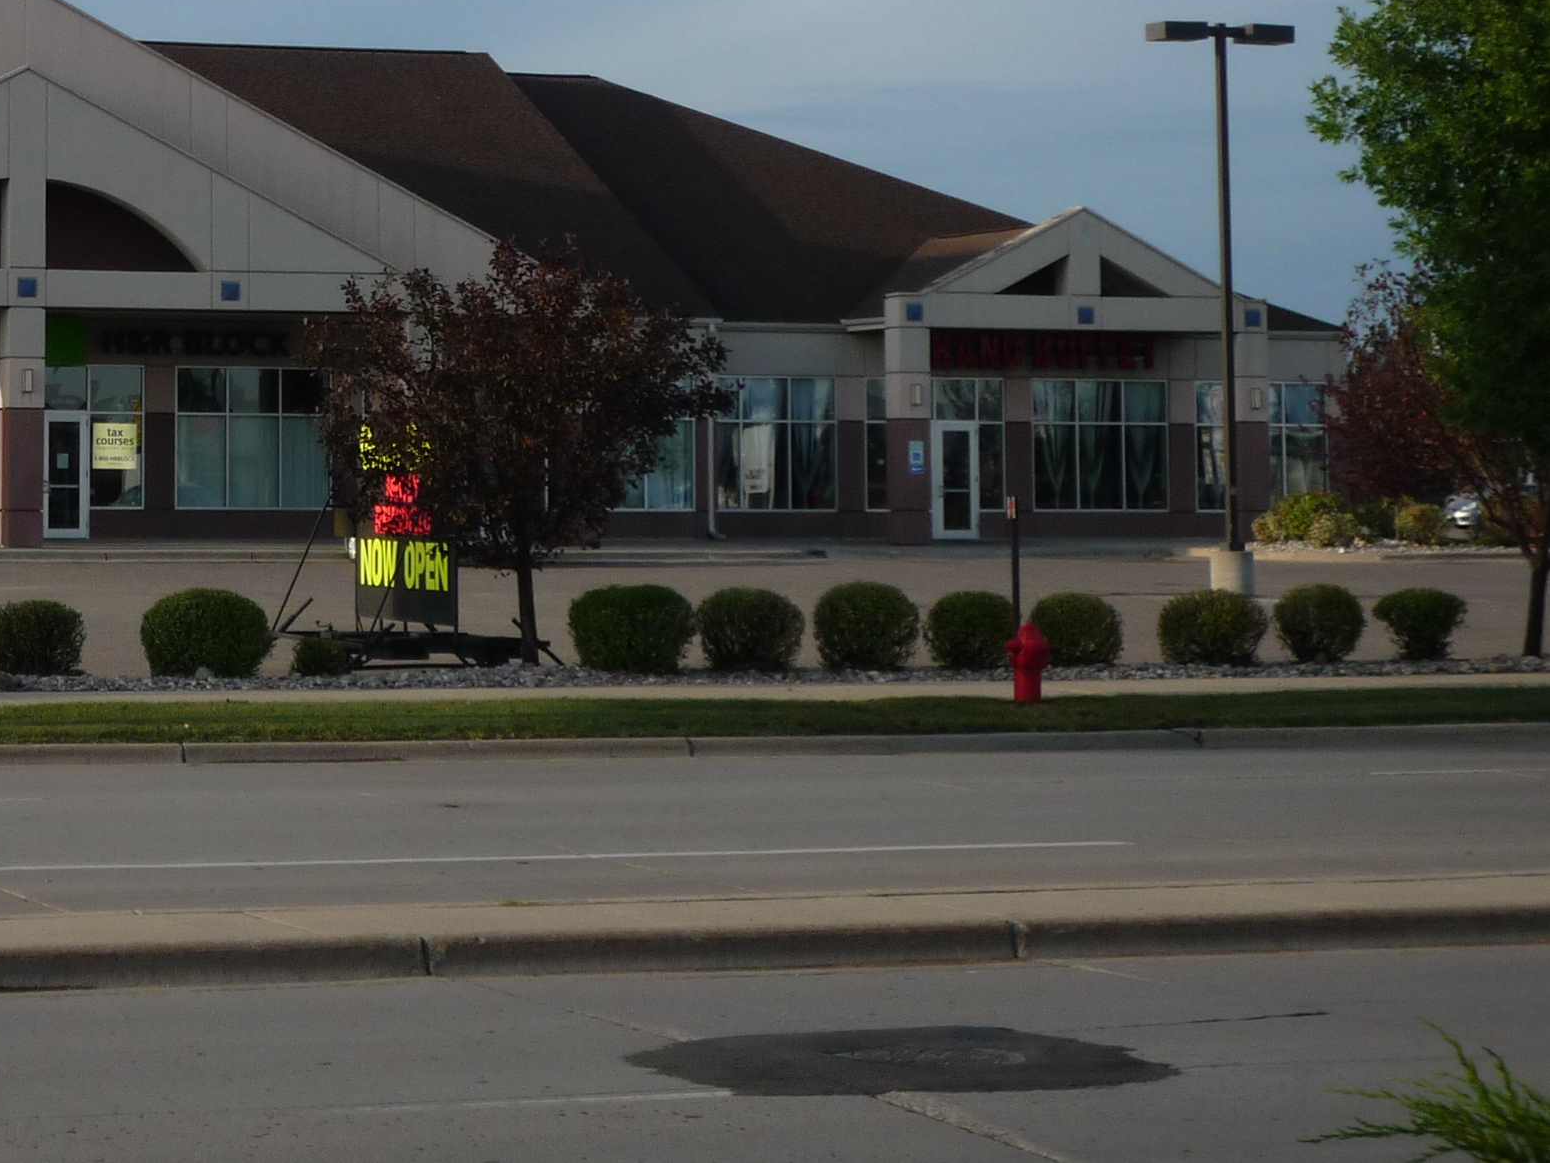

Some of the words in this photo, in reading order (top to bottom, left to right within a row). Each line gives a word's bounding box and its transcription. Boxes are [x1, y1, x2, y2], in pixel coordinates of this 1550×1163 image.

[184, 329, 291, 356] BLOCK
[96, 437, 135, 446] courses
[106, 428, 124, 437] tax
[359, 537, 399, 588] NOW
[403, 540, 449, 592] OPEN
